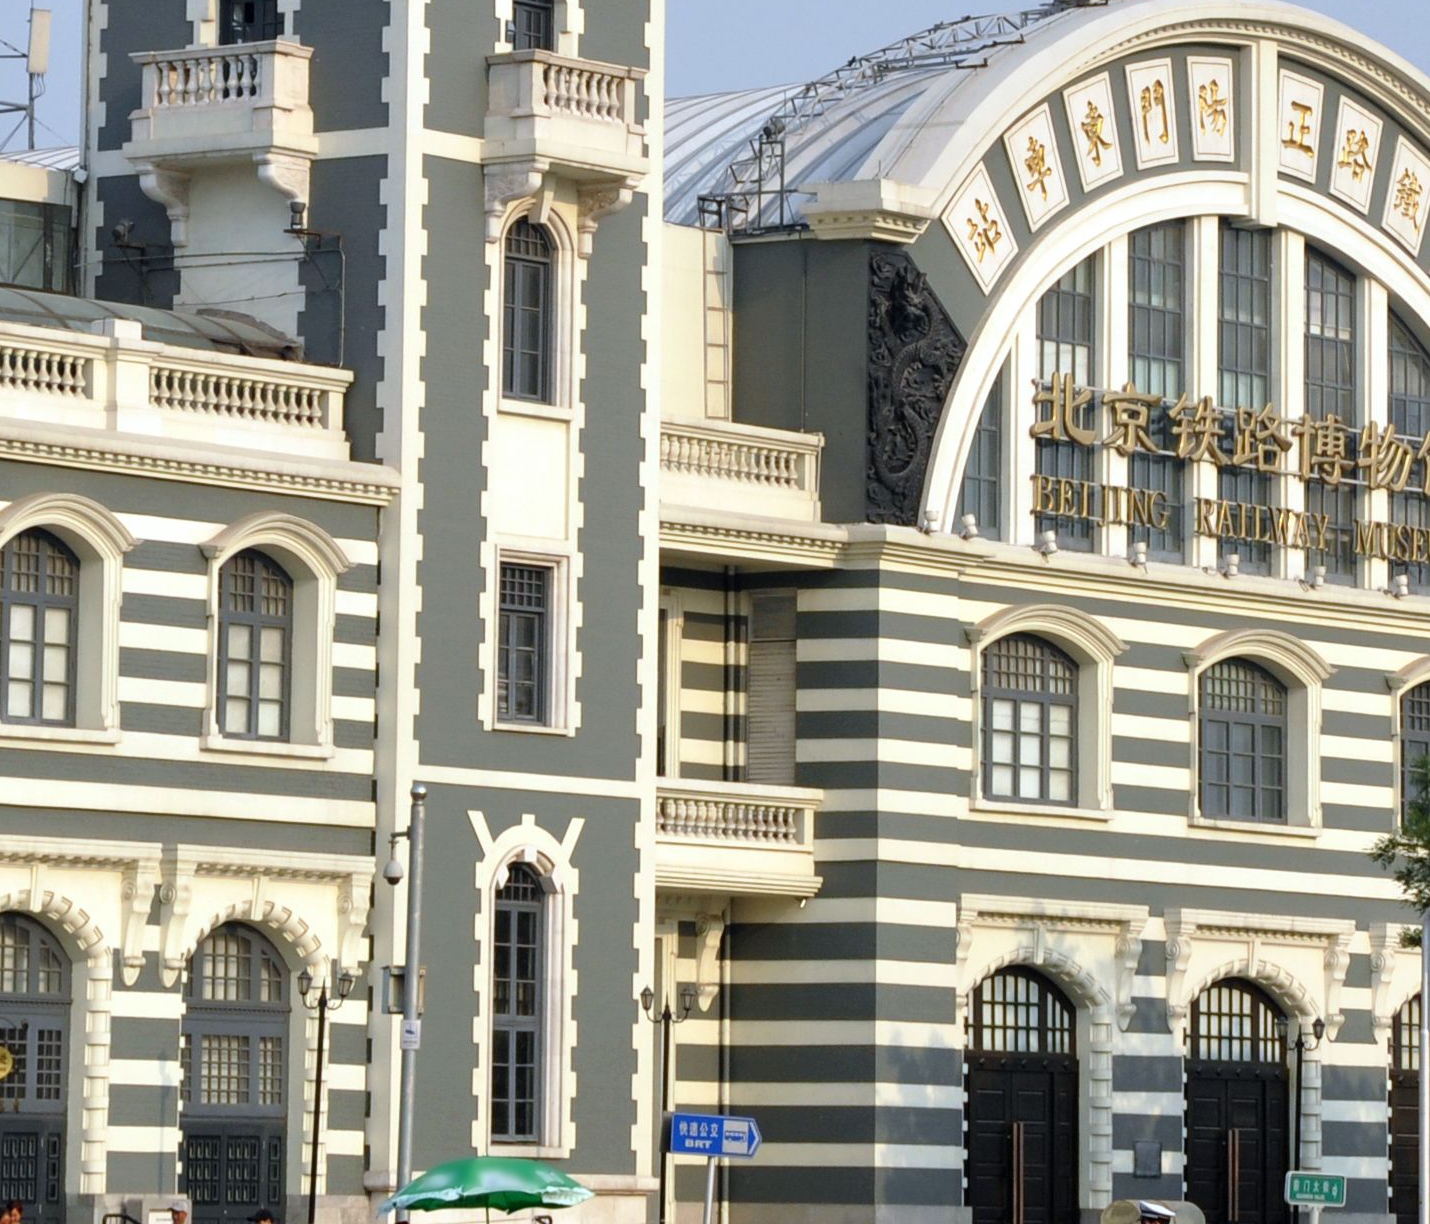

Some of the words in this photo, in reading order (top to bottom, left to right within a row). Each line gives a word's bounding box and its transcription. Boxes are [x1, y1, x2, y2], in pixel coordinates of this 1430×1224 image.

[1029, 474, 1169, 529] BEIJING
[1193, 496, 1329, 552] RAILWAY
[684, 1138, 713, 1149] BRT
